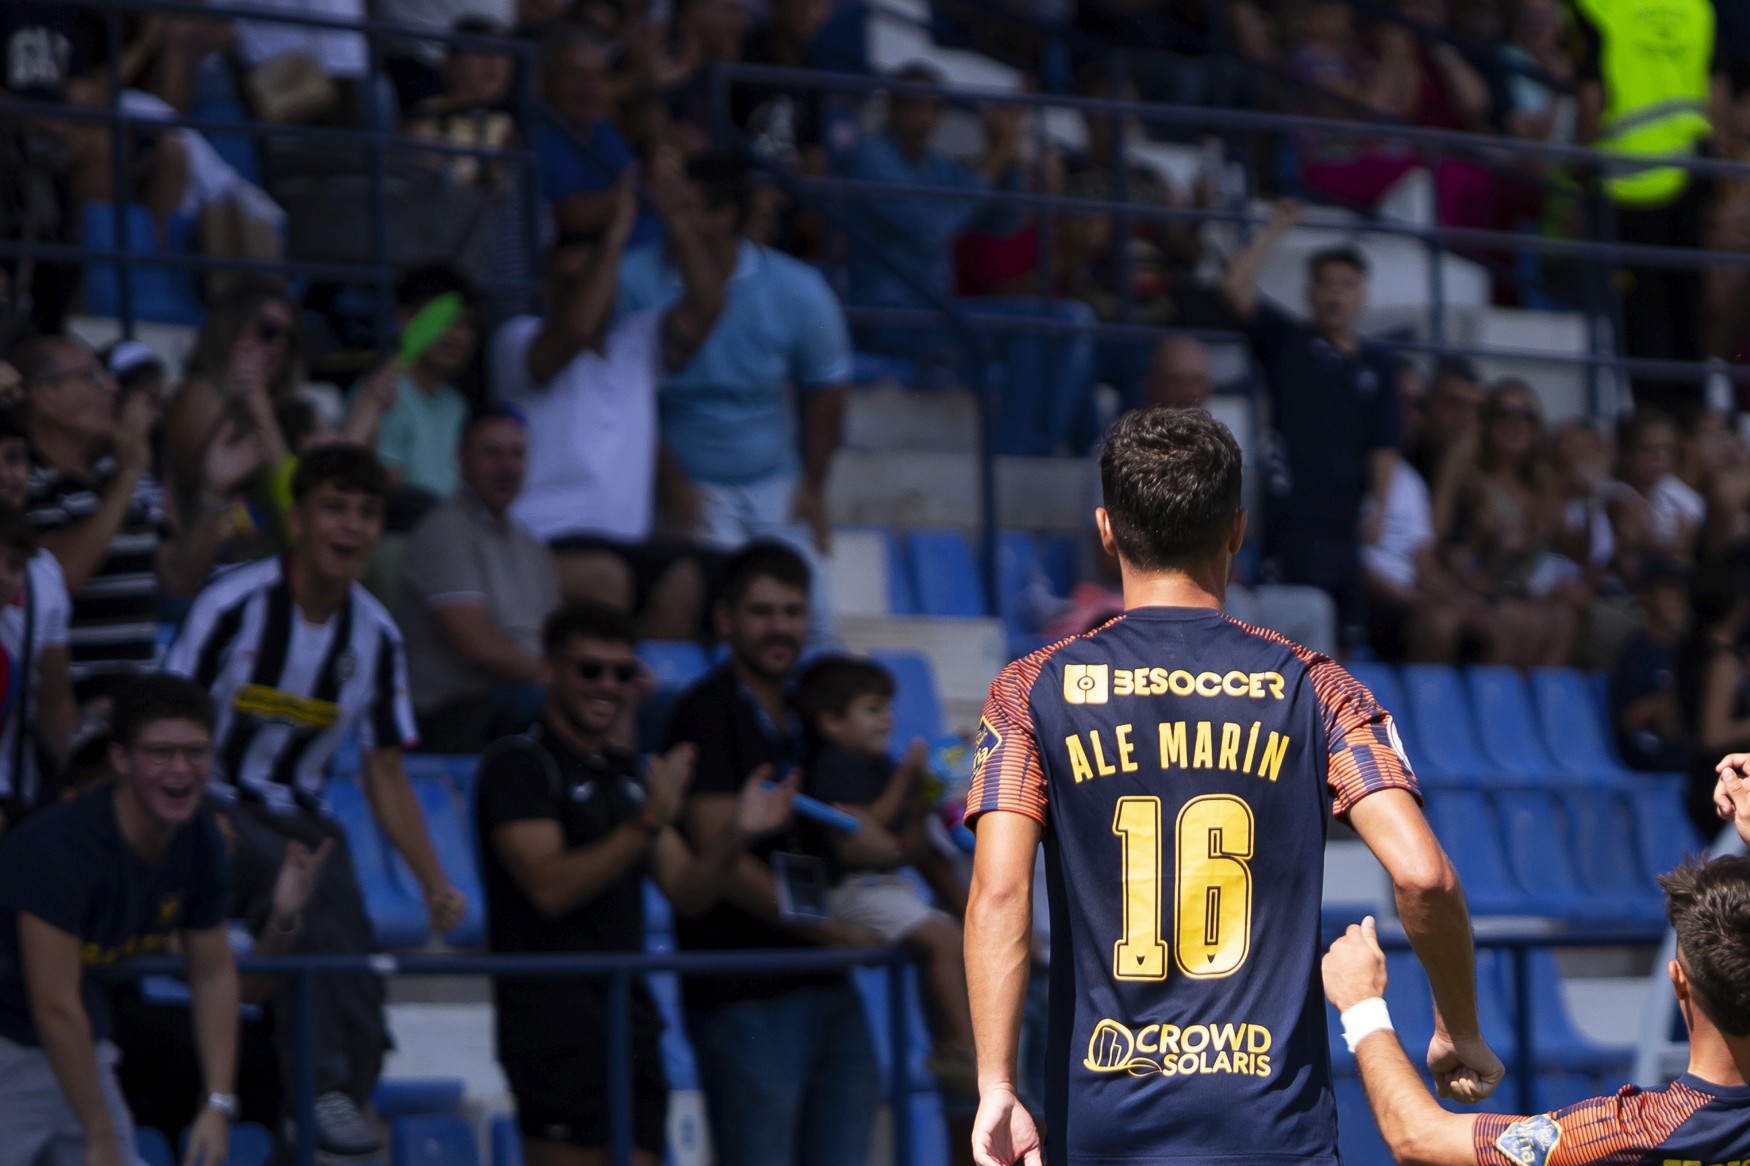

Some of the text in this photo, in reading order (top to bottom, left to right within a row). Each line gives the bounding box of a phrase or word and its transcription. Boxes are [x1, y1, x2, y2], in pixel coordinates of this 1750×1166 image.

[1113, 667, 1285, 700] BESOCCER
[1065, 721, 1290, 784] ALE MARÍN
[1112, 793, 1255, 981] 16
[1135, 1023, 1273, 1055] CROWD
[1161, 1050, 1272, 1078] SOLARIS
